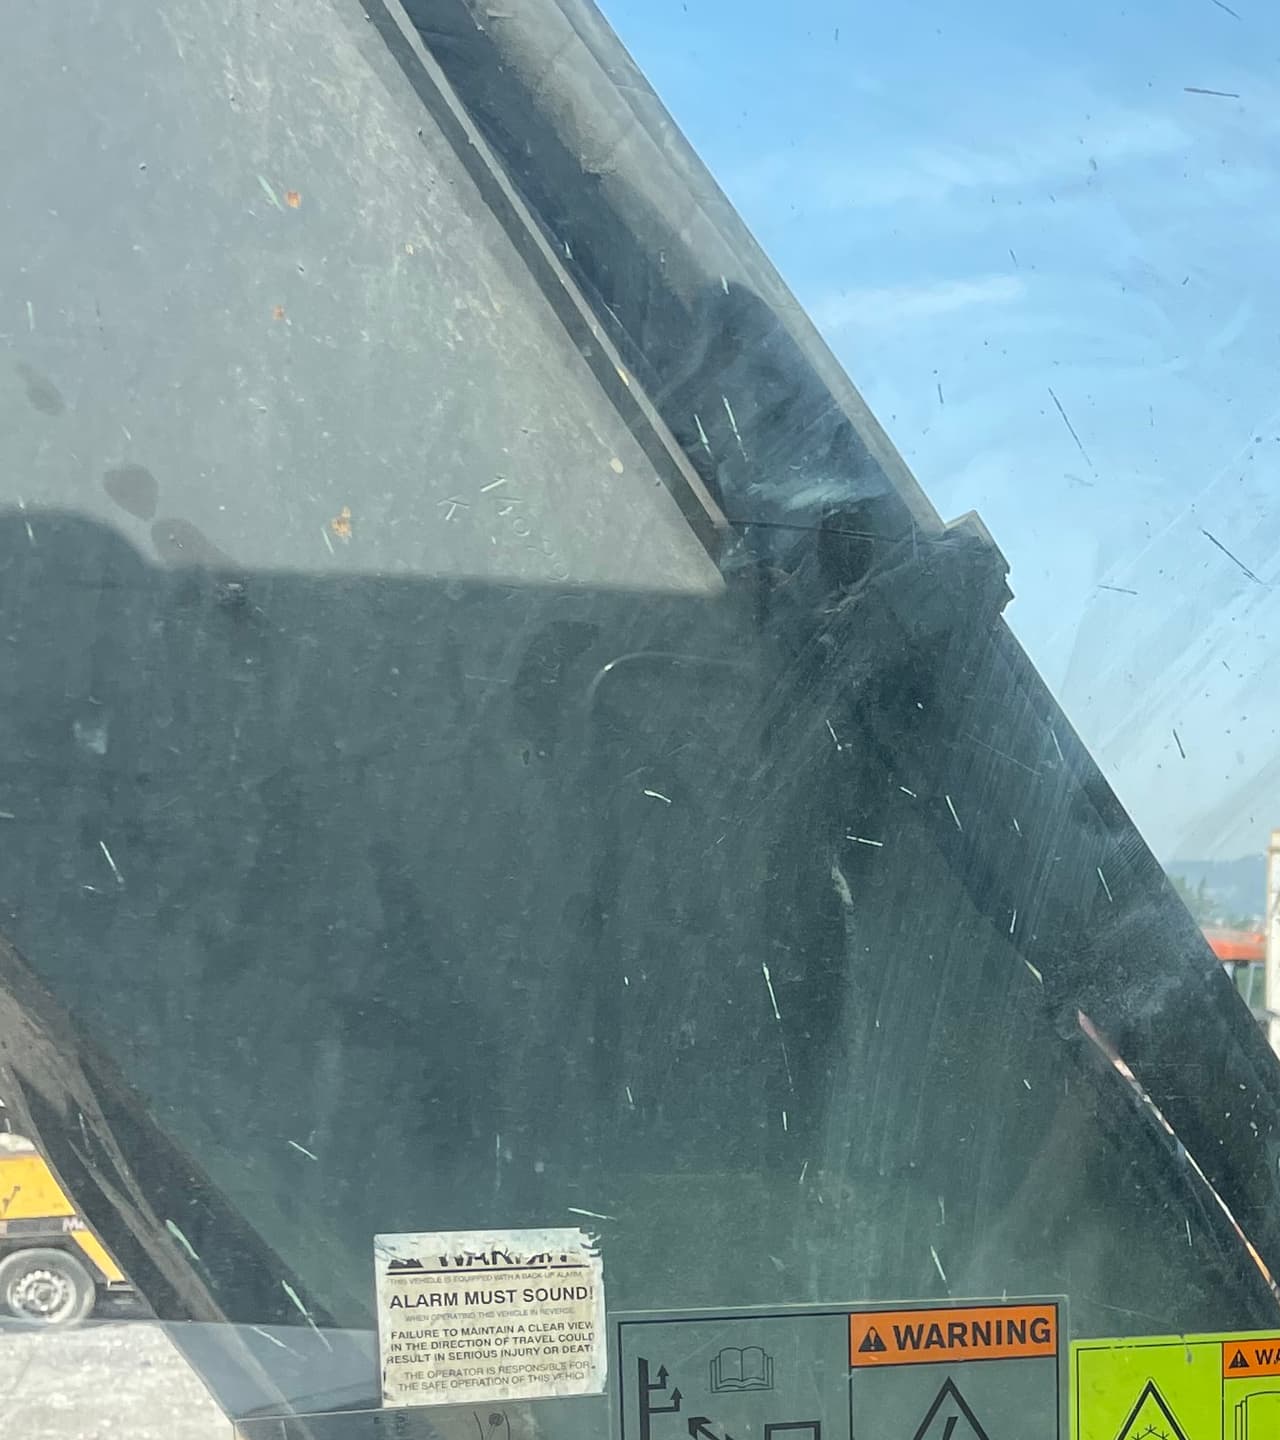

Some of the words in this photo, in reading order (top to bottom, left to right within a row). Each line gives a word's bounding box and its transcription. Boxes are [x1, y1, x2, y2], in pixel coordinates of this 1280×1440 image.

[390, 1291, 458, 1309] ALARM
[465, 1289, 517, 1305] MUST
[523, 1286, 593, 1302] SOUND!
[391, 1328, 440, 1340] FAILURE
[443, 1328, 458, 1338] TO
[461, 1325, 514, 1337] MAINTAIN
[517, 1325, 526, 1333] A
[528, 1322, 565, 1333] CLEAR
[892, 1317, 1050, 1351] WARNING
[391, 1343, 402, 1352] IN
[406, 1341, 428, 1351] THE
[430, 1337, 491, 1350] DIRECTION
[494, 1336, 510, 1346] OF
[512, 1333, 556, 1345] TRAVEL
[558, 1332, 595, 1343] COULD
[387, 1353, 431, 1364] RESULT
[434, 1352, 445, 1362] IN
[448, 1349, 498, 1361] SERIOUS
[501, 1347, 540, 1358] INJURY
[543, 1345, 559, 1355] OR
[404, 1370, 425, 1380] THE
[427, 1367, 484, 1379] OPERATOR
[486, 1366, 496, 1375] IS
[498, 1361, 567, 1375] RESPONSIBLE
[569, 1360, 590, 1370] FOR
[398, 1382, 419, 1392] THE
[421, 1379, 447, 1391] SAFE
[450, 1376, 509, 1389] OPERATION
[511, 1375, 526, 1385] OF
[528, 1372, 550, 1383] THIS
